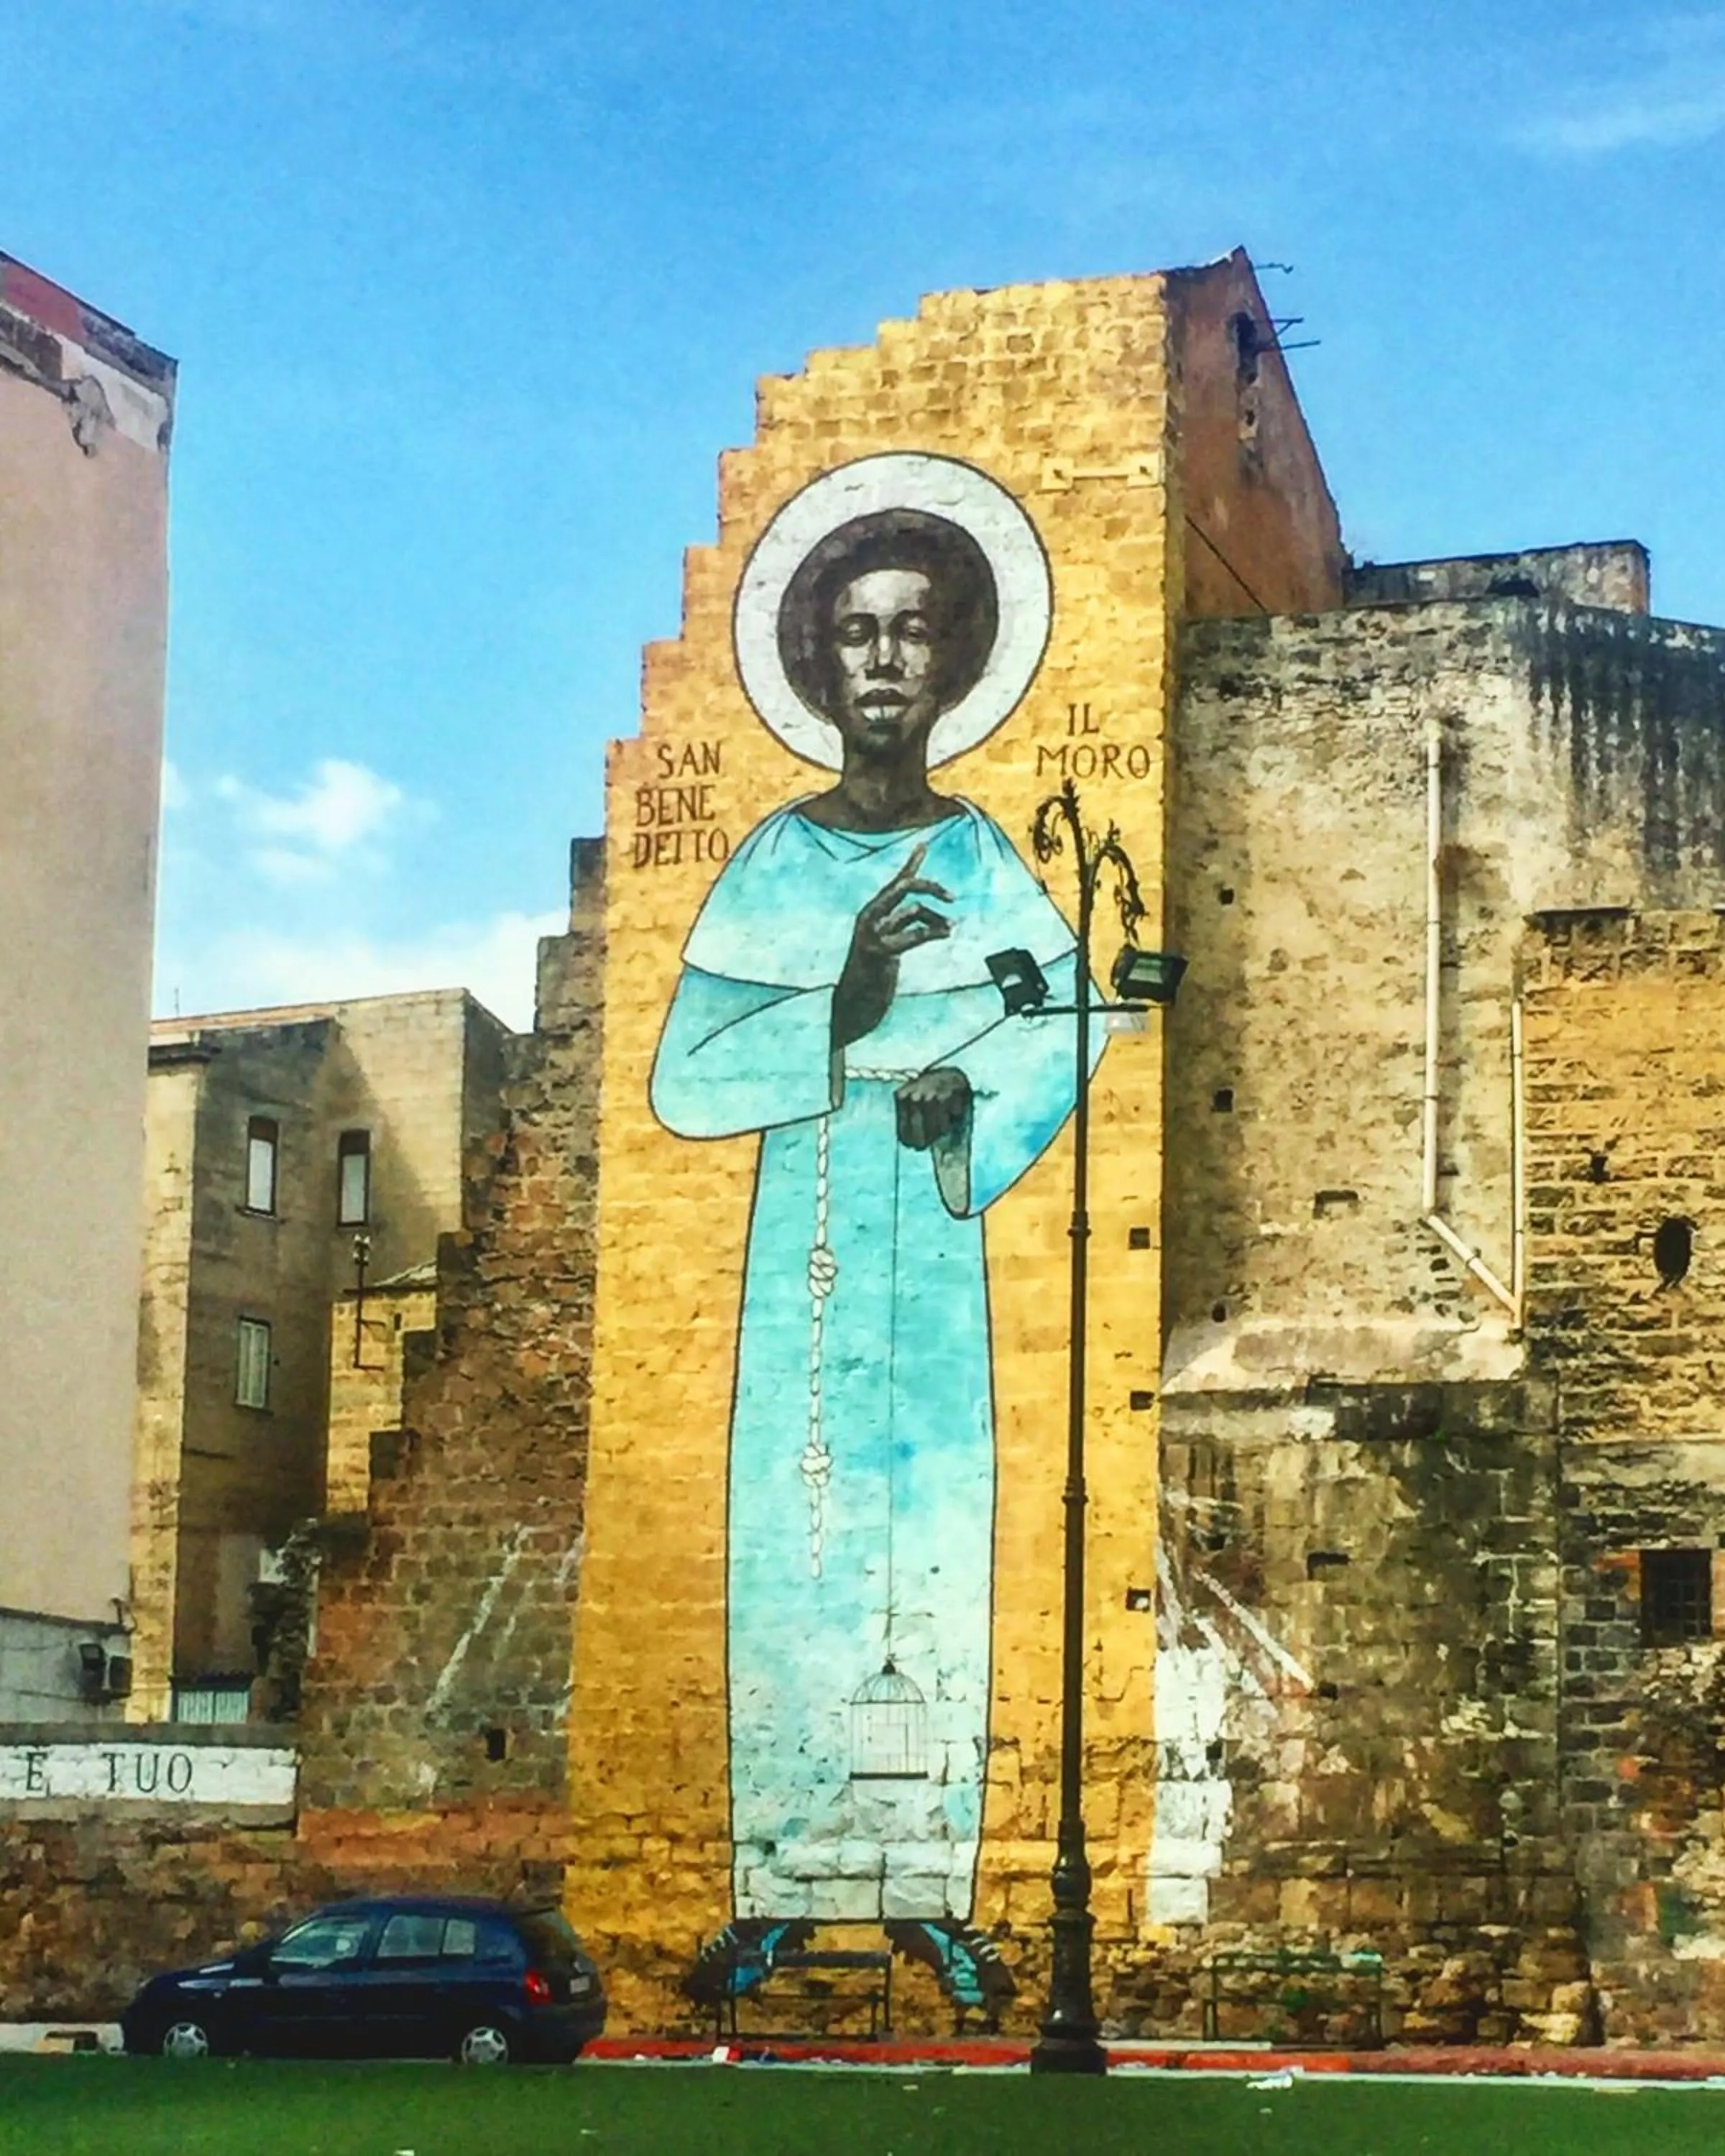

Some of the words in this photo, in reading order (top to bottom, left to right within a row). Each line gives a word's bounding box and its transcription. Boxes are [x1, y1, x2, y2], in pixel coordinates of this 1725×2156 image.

[1067, 702, 1100, 737] IL
[657, 740, 722, 779] SAN
[1036, 744, 1151, 780] MORO
[635, 785, 716, 826] BENE
[632, 828, 730, 870] DETTO
[102, 1751, 194, 1795] TUO
